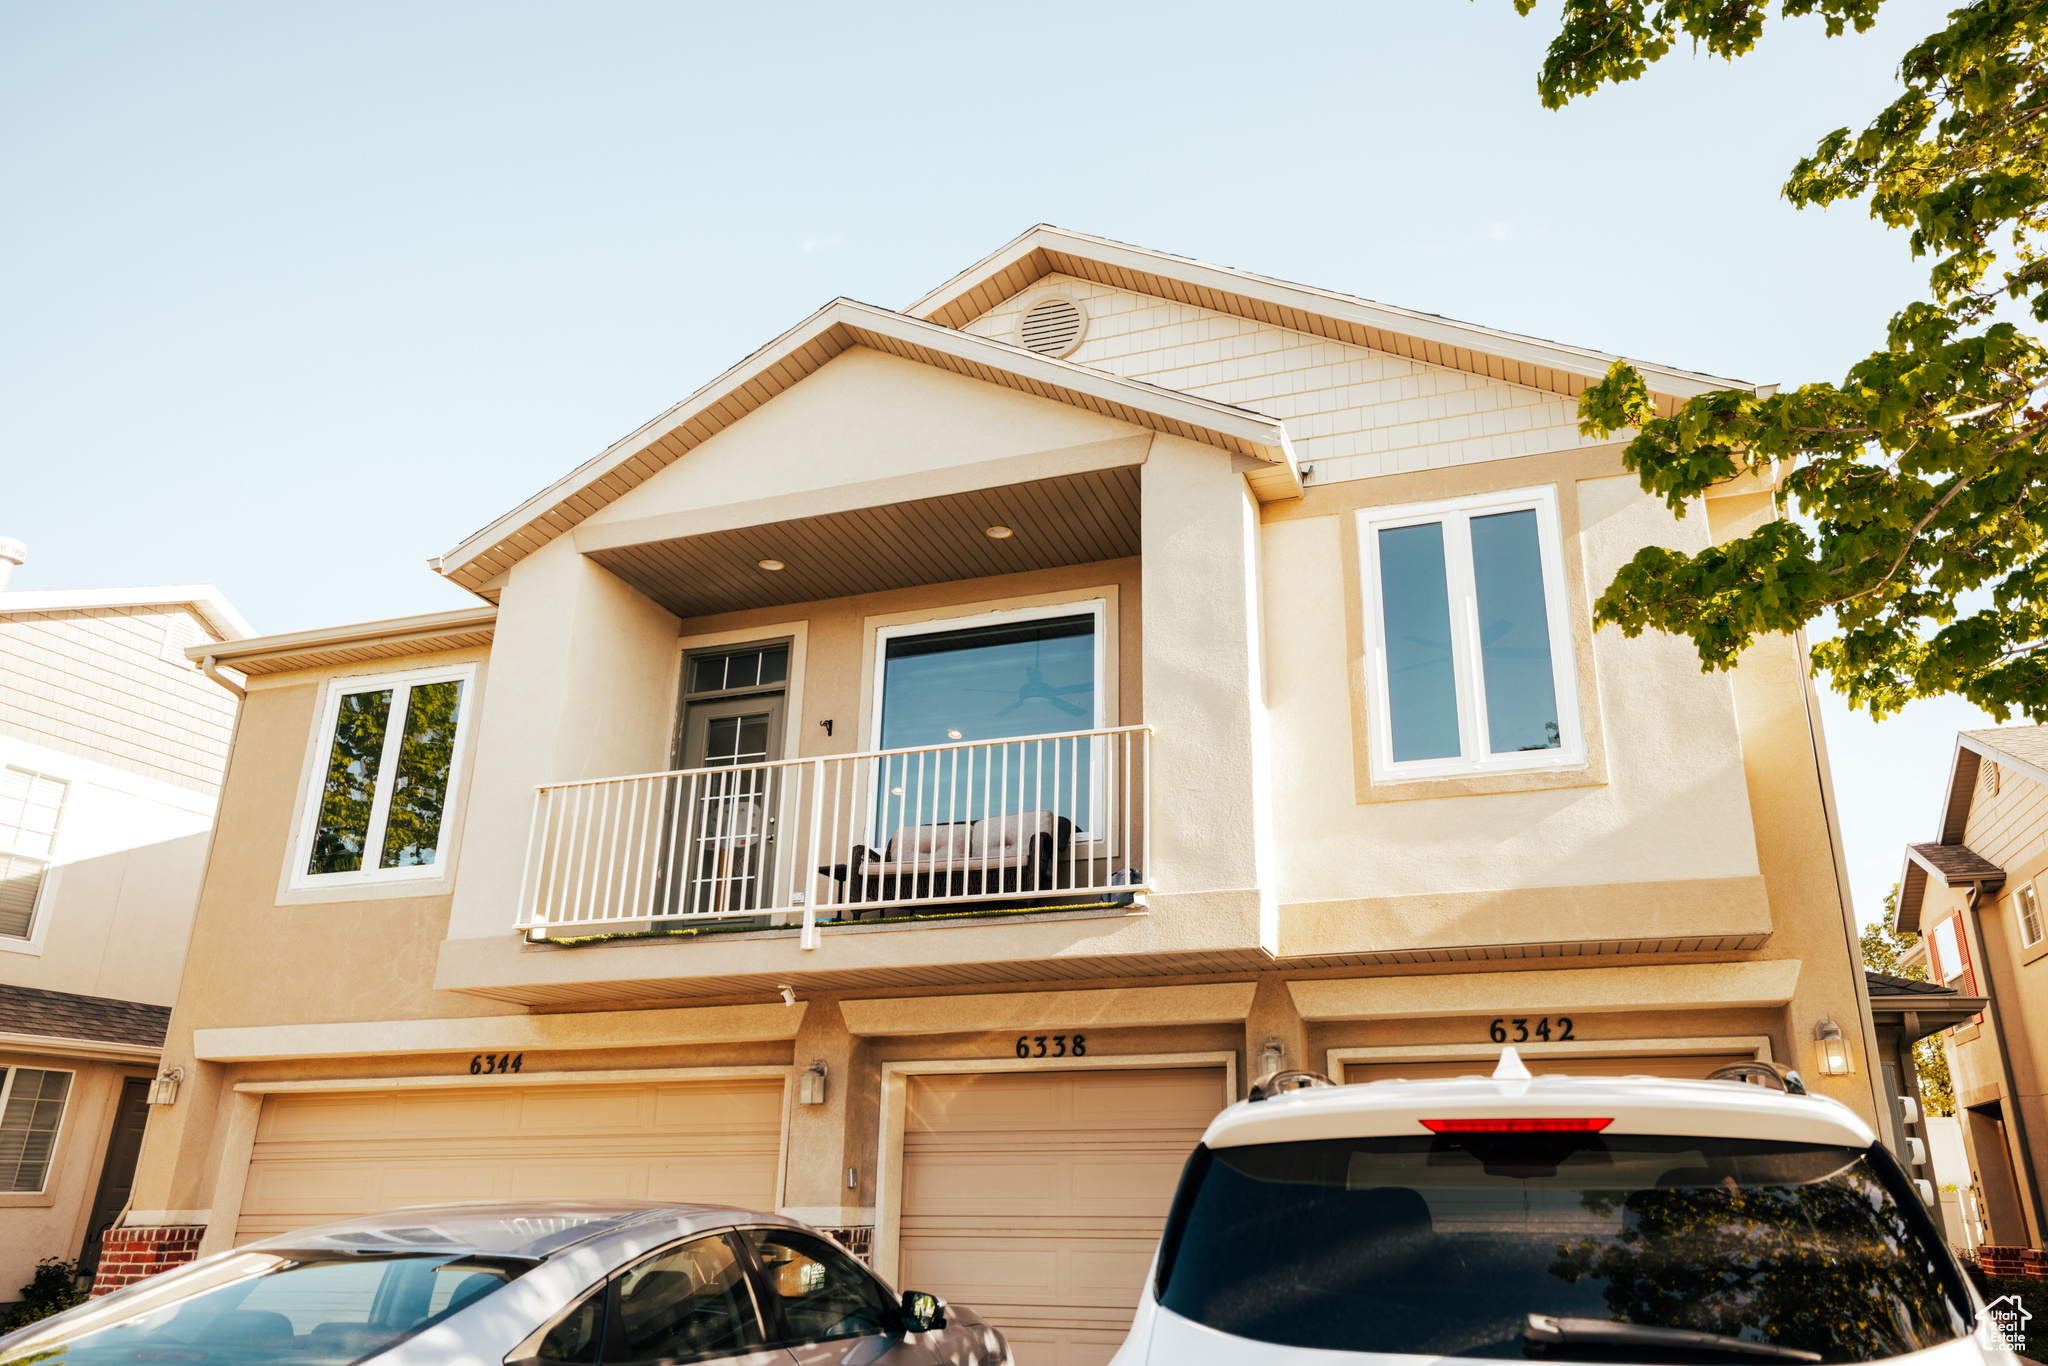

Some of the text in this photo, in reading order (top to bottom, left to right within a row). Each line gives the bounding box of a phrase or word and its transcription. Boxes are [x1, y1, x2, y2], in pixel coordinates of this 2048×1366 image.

[1490, 1017, 1575, 1043] 6342
[1016, 1034, 1086, 1058] 6338
[470, 1053, 523, 1075] 6344
